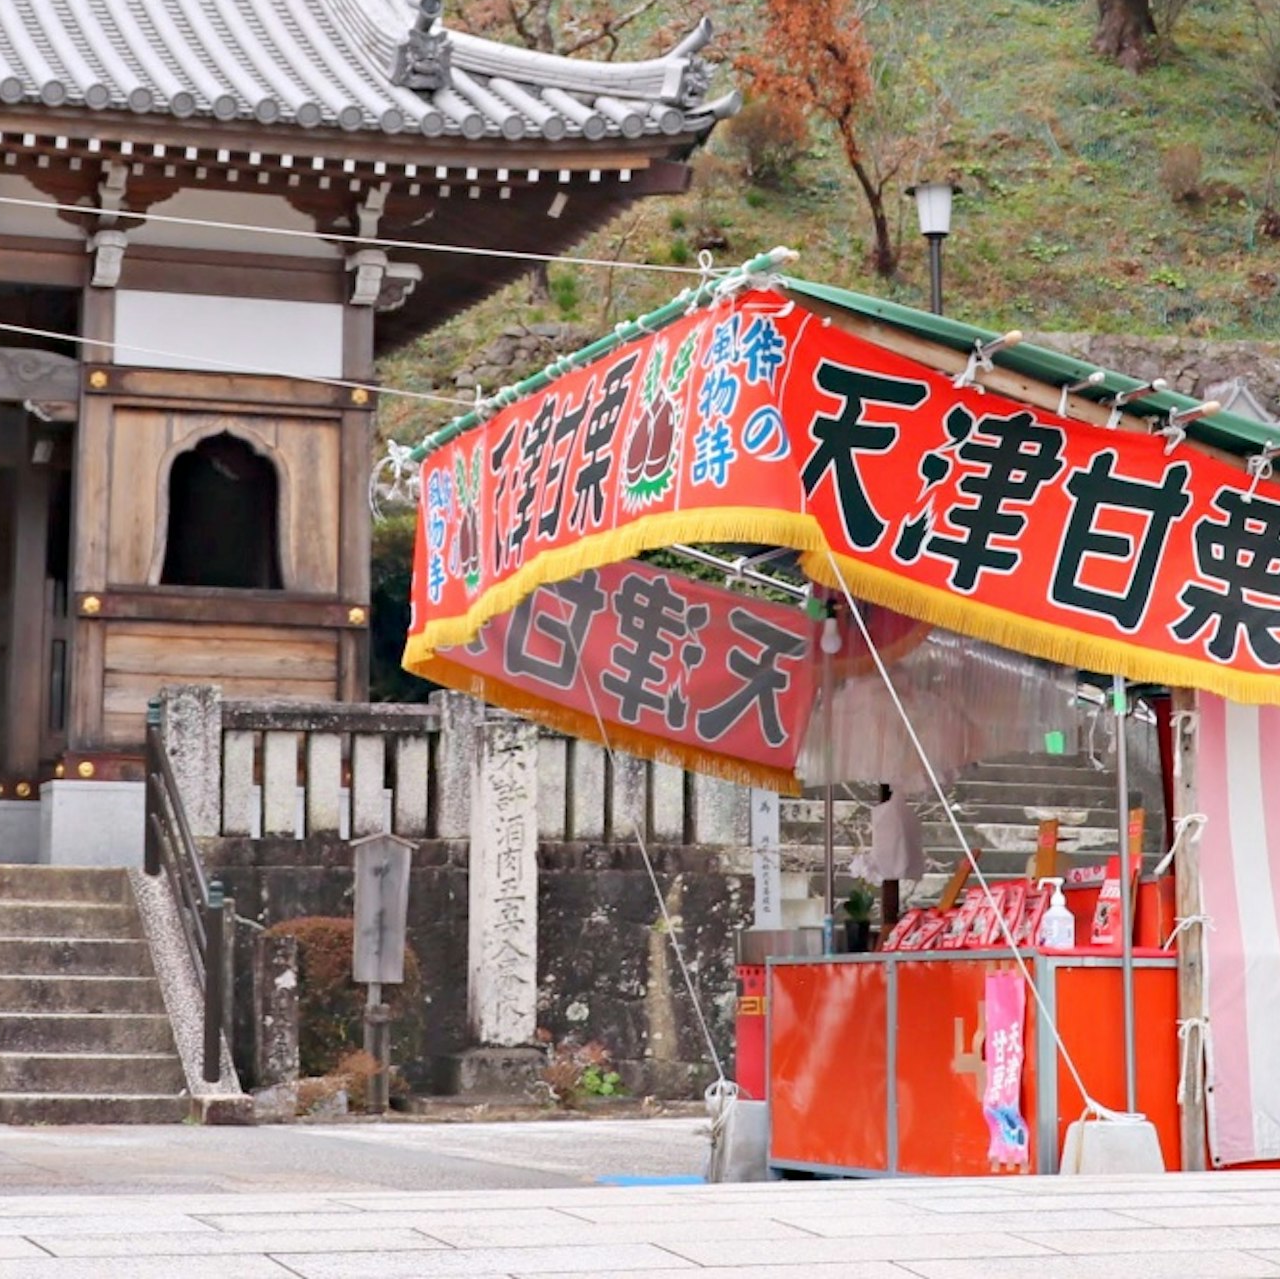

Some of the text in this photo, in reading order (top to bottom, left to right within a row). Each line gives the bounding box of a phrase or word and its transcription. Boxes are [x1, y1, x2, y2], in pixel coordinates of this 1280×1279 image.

[490, 348, 641, 577] 天津甘栗
[691, 312, 742, 487] 風物詩
